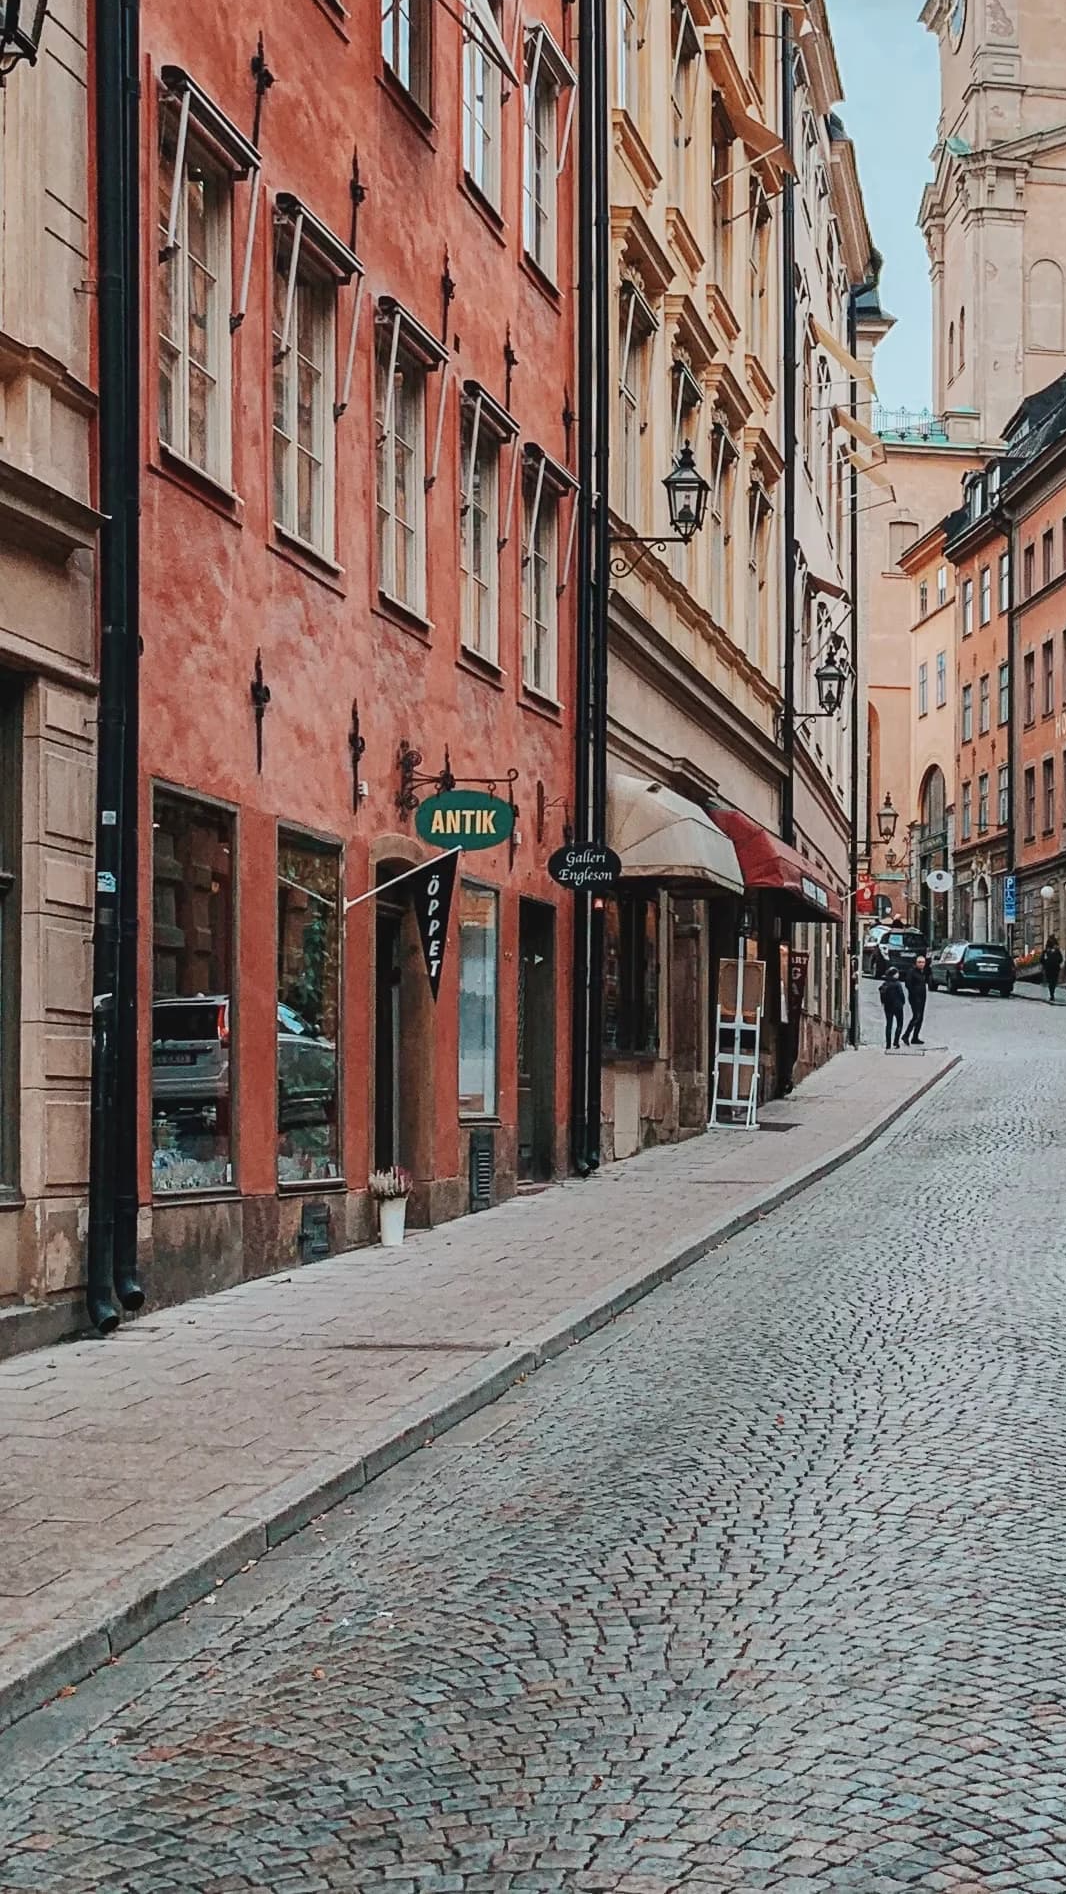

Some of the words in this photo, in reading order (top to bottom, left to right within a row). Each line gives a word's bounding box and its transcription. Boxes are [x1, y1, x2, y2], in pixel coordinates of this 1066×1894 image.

[431, 810, 496, 834] ANTIK
[566, 849, 606, 867] Galleri
[558, 866, 612, 886] Engleson
[427, 875, 440, 977] ÖPPET
